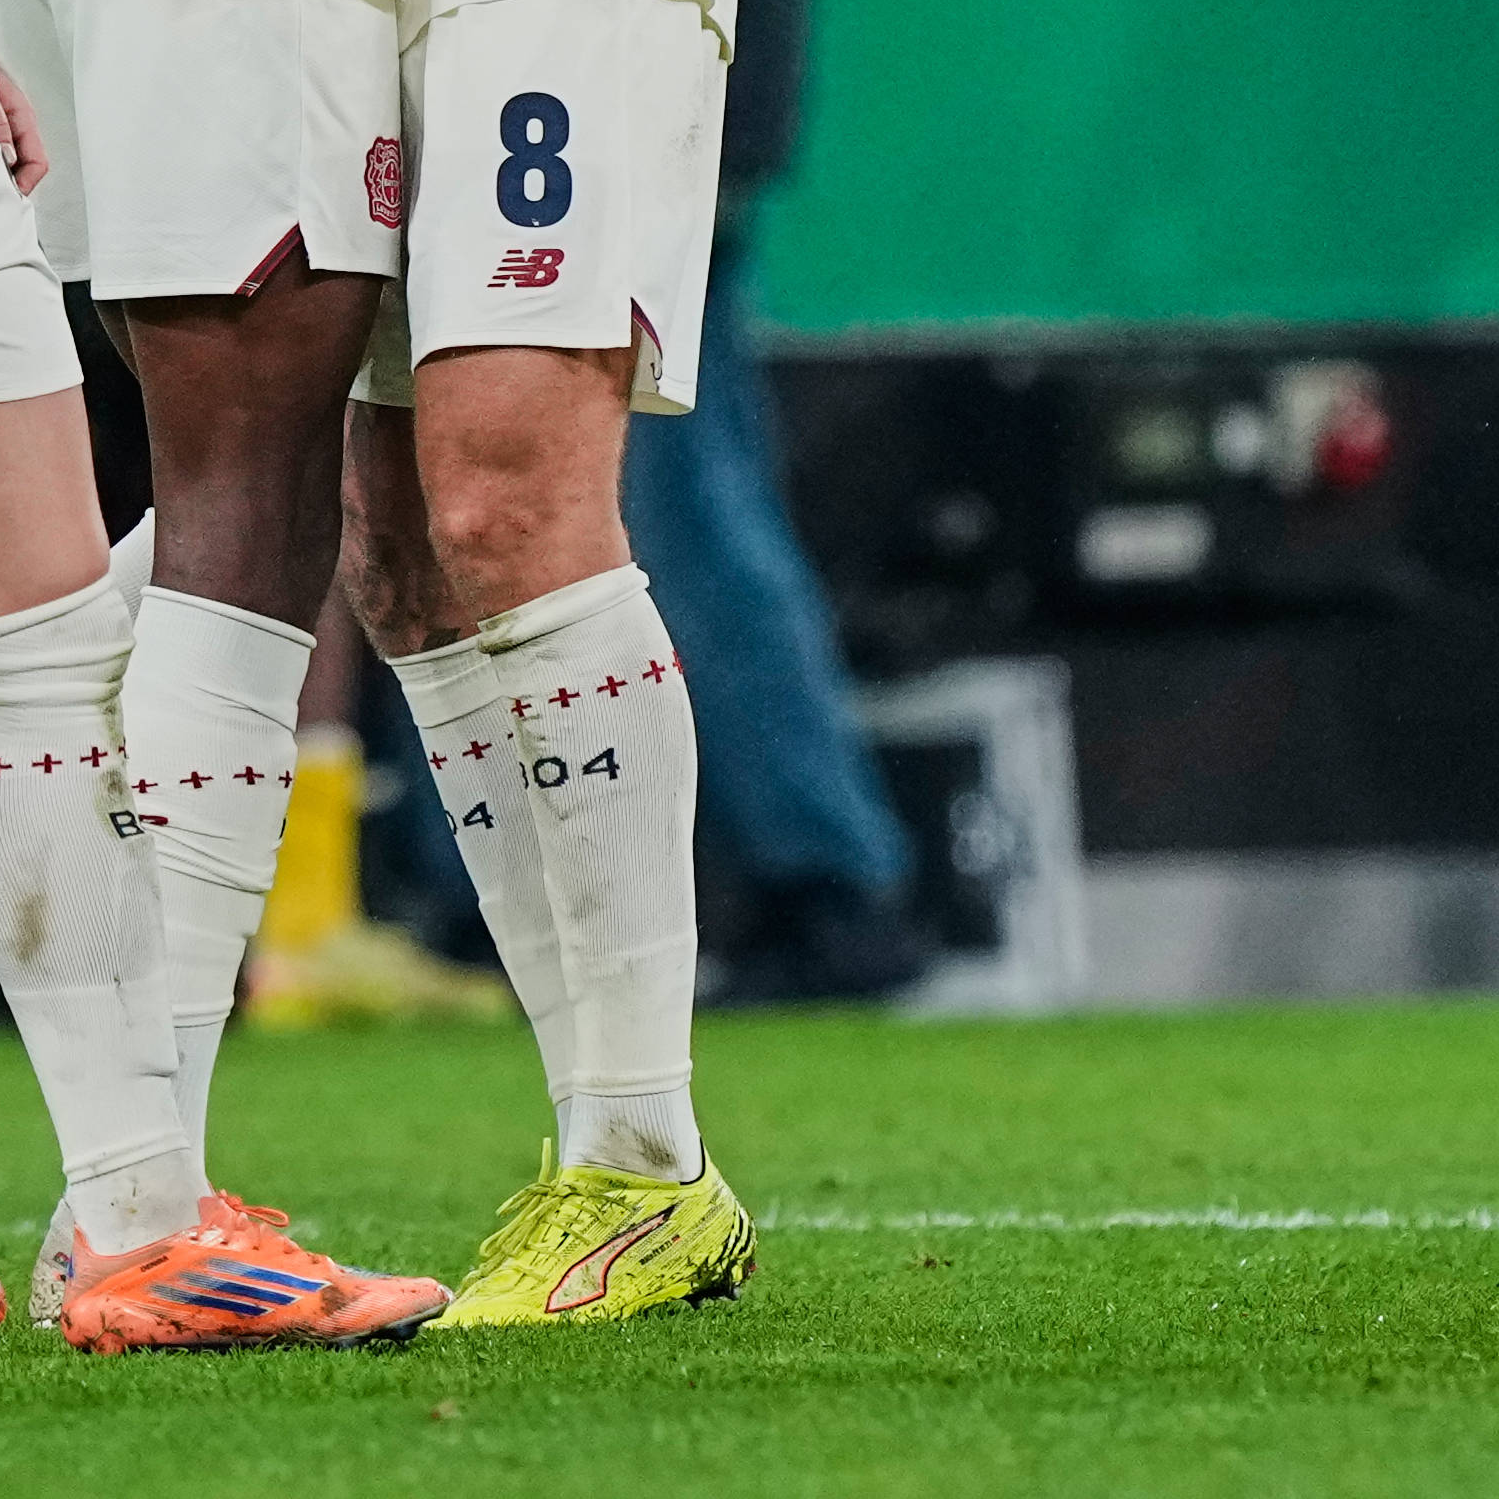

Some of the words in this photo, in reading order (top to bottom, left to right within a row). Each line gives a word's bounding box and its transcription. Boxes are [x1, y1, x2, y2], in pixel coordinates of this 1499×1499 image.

[496, 92, 573, 228] 8
[487, 248, 565, 289] NB
[518, 747, 621, 791] 04
